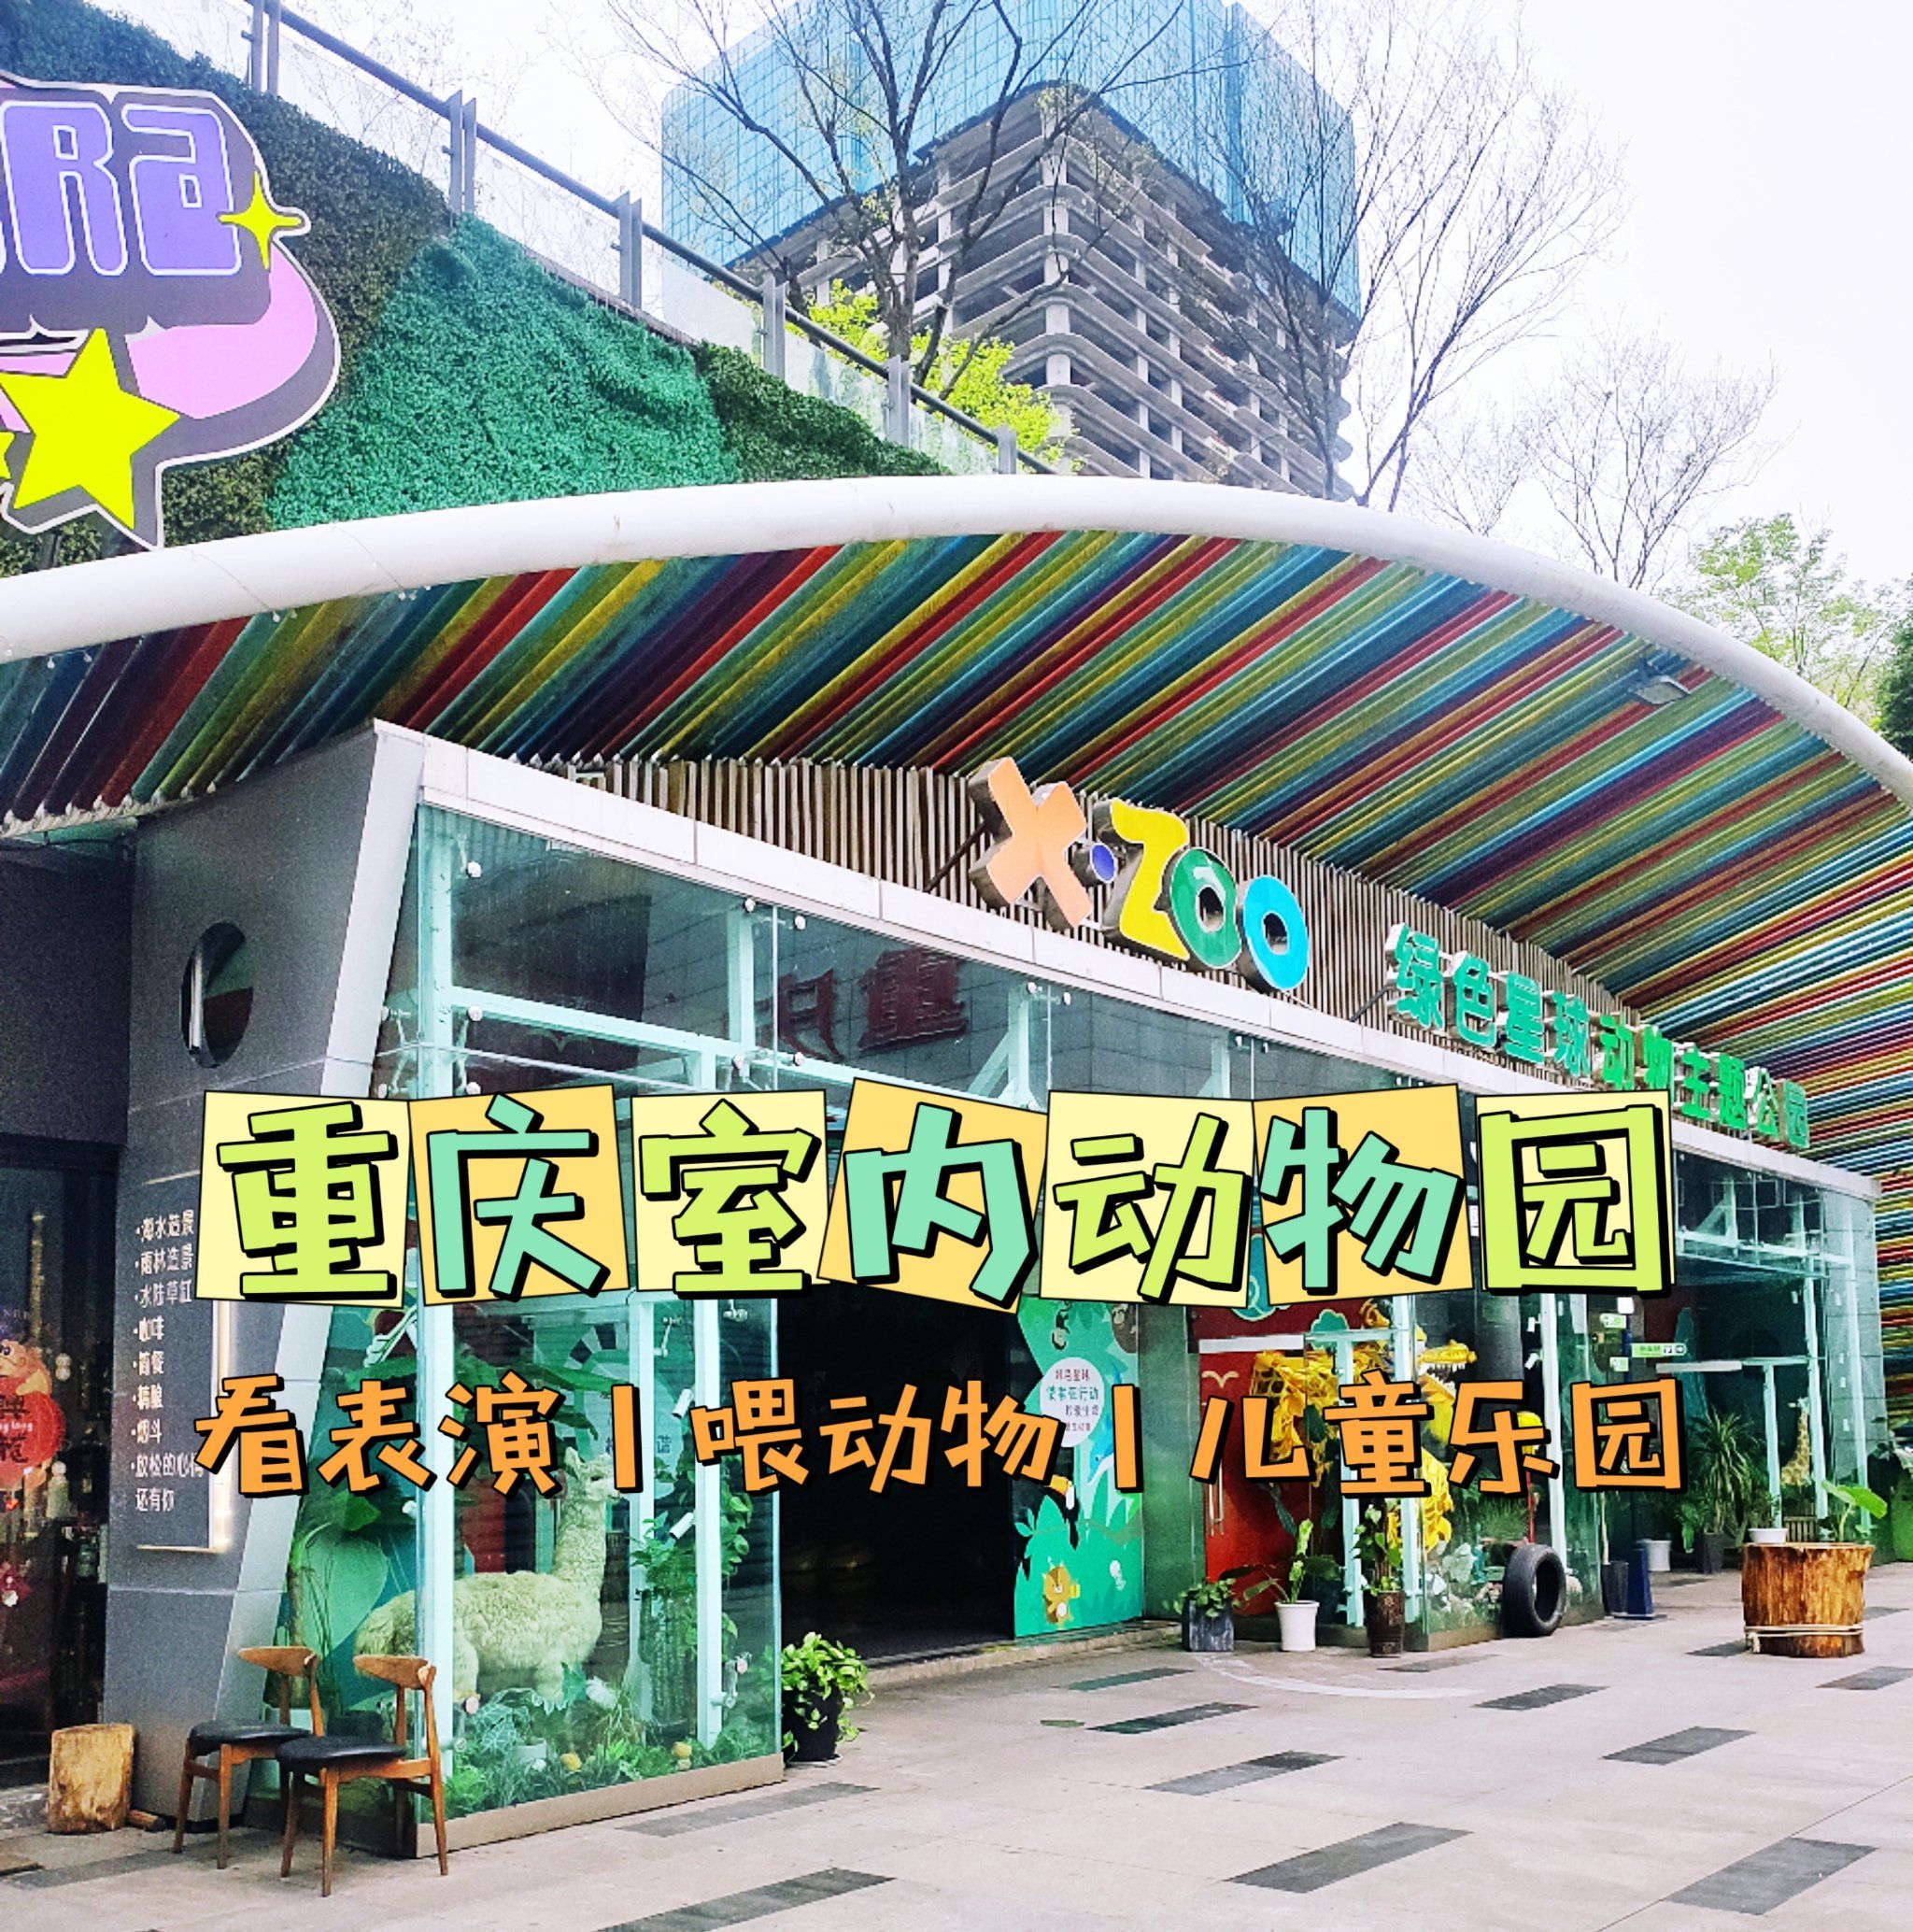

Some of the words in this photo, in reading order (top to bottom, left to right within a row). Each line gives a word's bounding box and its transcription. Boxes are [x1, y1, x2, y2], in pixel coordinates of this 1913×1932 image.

[1385, 922, 1810, 1149] 绿色星球动物主题公园
